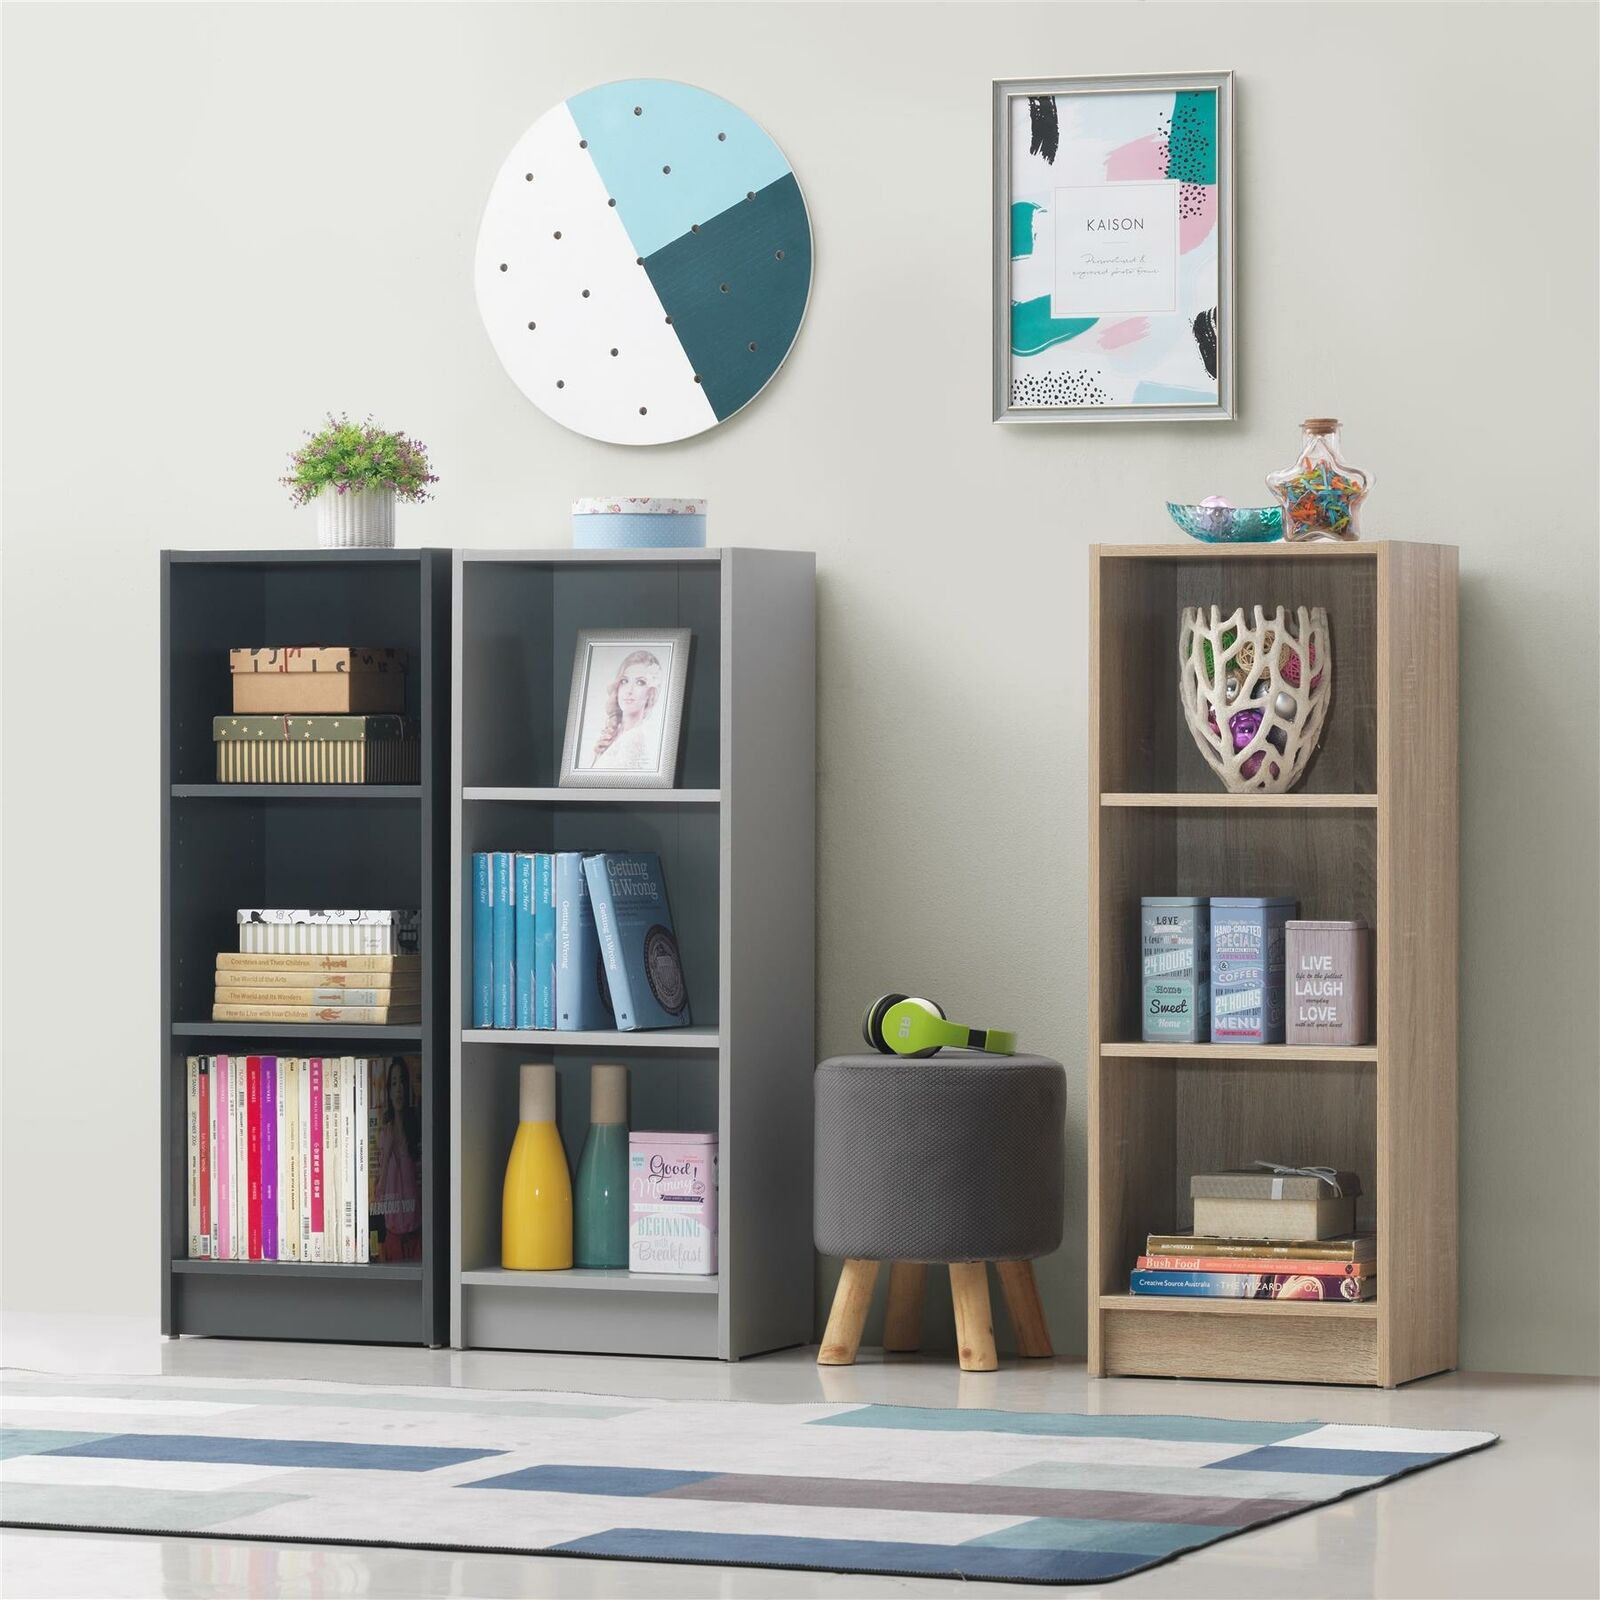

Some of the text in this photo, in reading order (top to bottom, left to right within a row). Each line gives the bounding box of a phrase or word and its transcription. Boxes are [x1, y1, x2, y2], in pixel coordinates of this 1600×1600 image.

[1086, 218, 1144, 231] KAISON
[606, 859, 648, 880] Getting
[609, 878, 658, 900] It Wrong
[561, 900, 570, 932] Getting
[1156, 916, 1178, 926] LOVE
[600, 902, 610, 934] Getting
[606, 942, 618, 970] Wrong
[1215, 924, 1262, 938] HAND-CRAFTED
[1216, 933, 1261, 948] SPECIALS
[561, 940, 570, 969] Wrong
[1160, 950, 1192, 971] HOURS
[1302, 956, 1332, 970] LIVE
[1219, 970, 1258, 982] COFFEE
[1155, 986, 1182, 994] Home
[1296, 982, 1343, 996] LAUGH
[1150, 999, 1188, 1014] Sweet
[1230, 989, 1261, 1011] HOURS
[1300, 1006, 1336, 1021] LOVE
[1215, 1017, 1260, 1030] MENU
[638, 1217, 700, 1238] BEGINNING
[632, 1240, 702, 1269] Breakfast
[1146, 1258, 1200, 1269] Bush Food
[1220, 1281, 1240, 1290] THE
[1241, 1282, 1282, 1291] WIZARD
[1304, 1284, 1319, 1292] OZ
